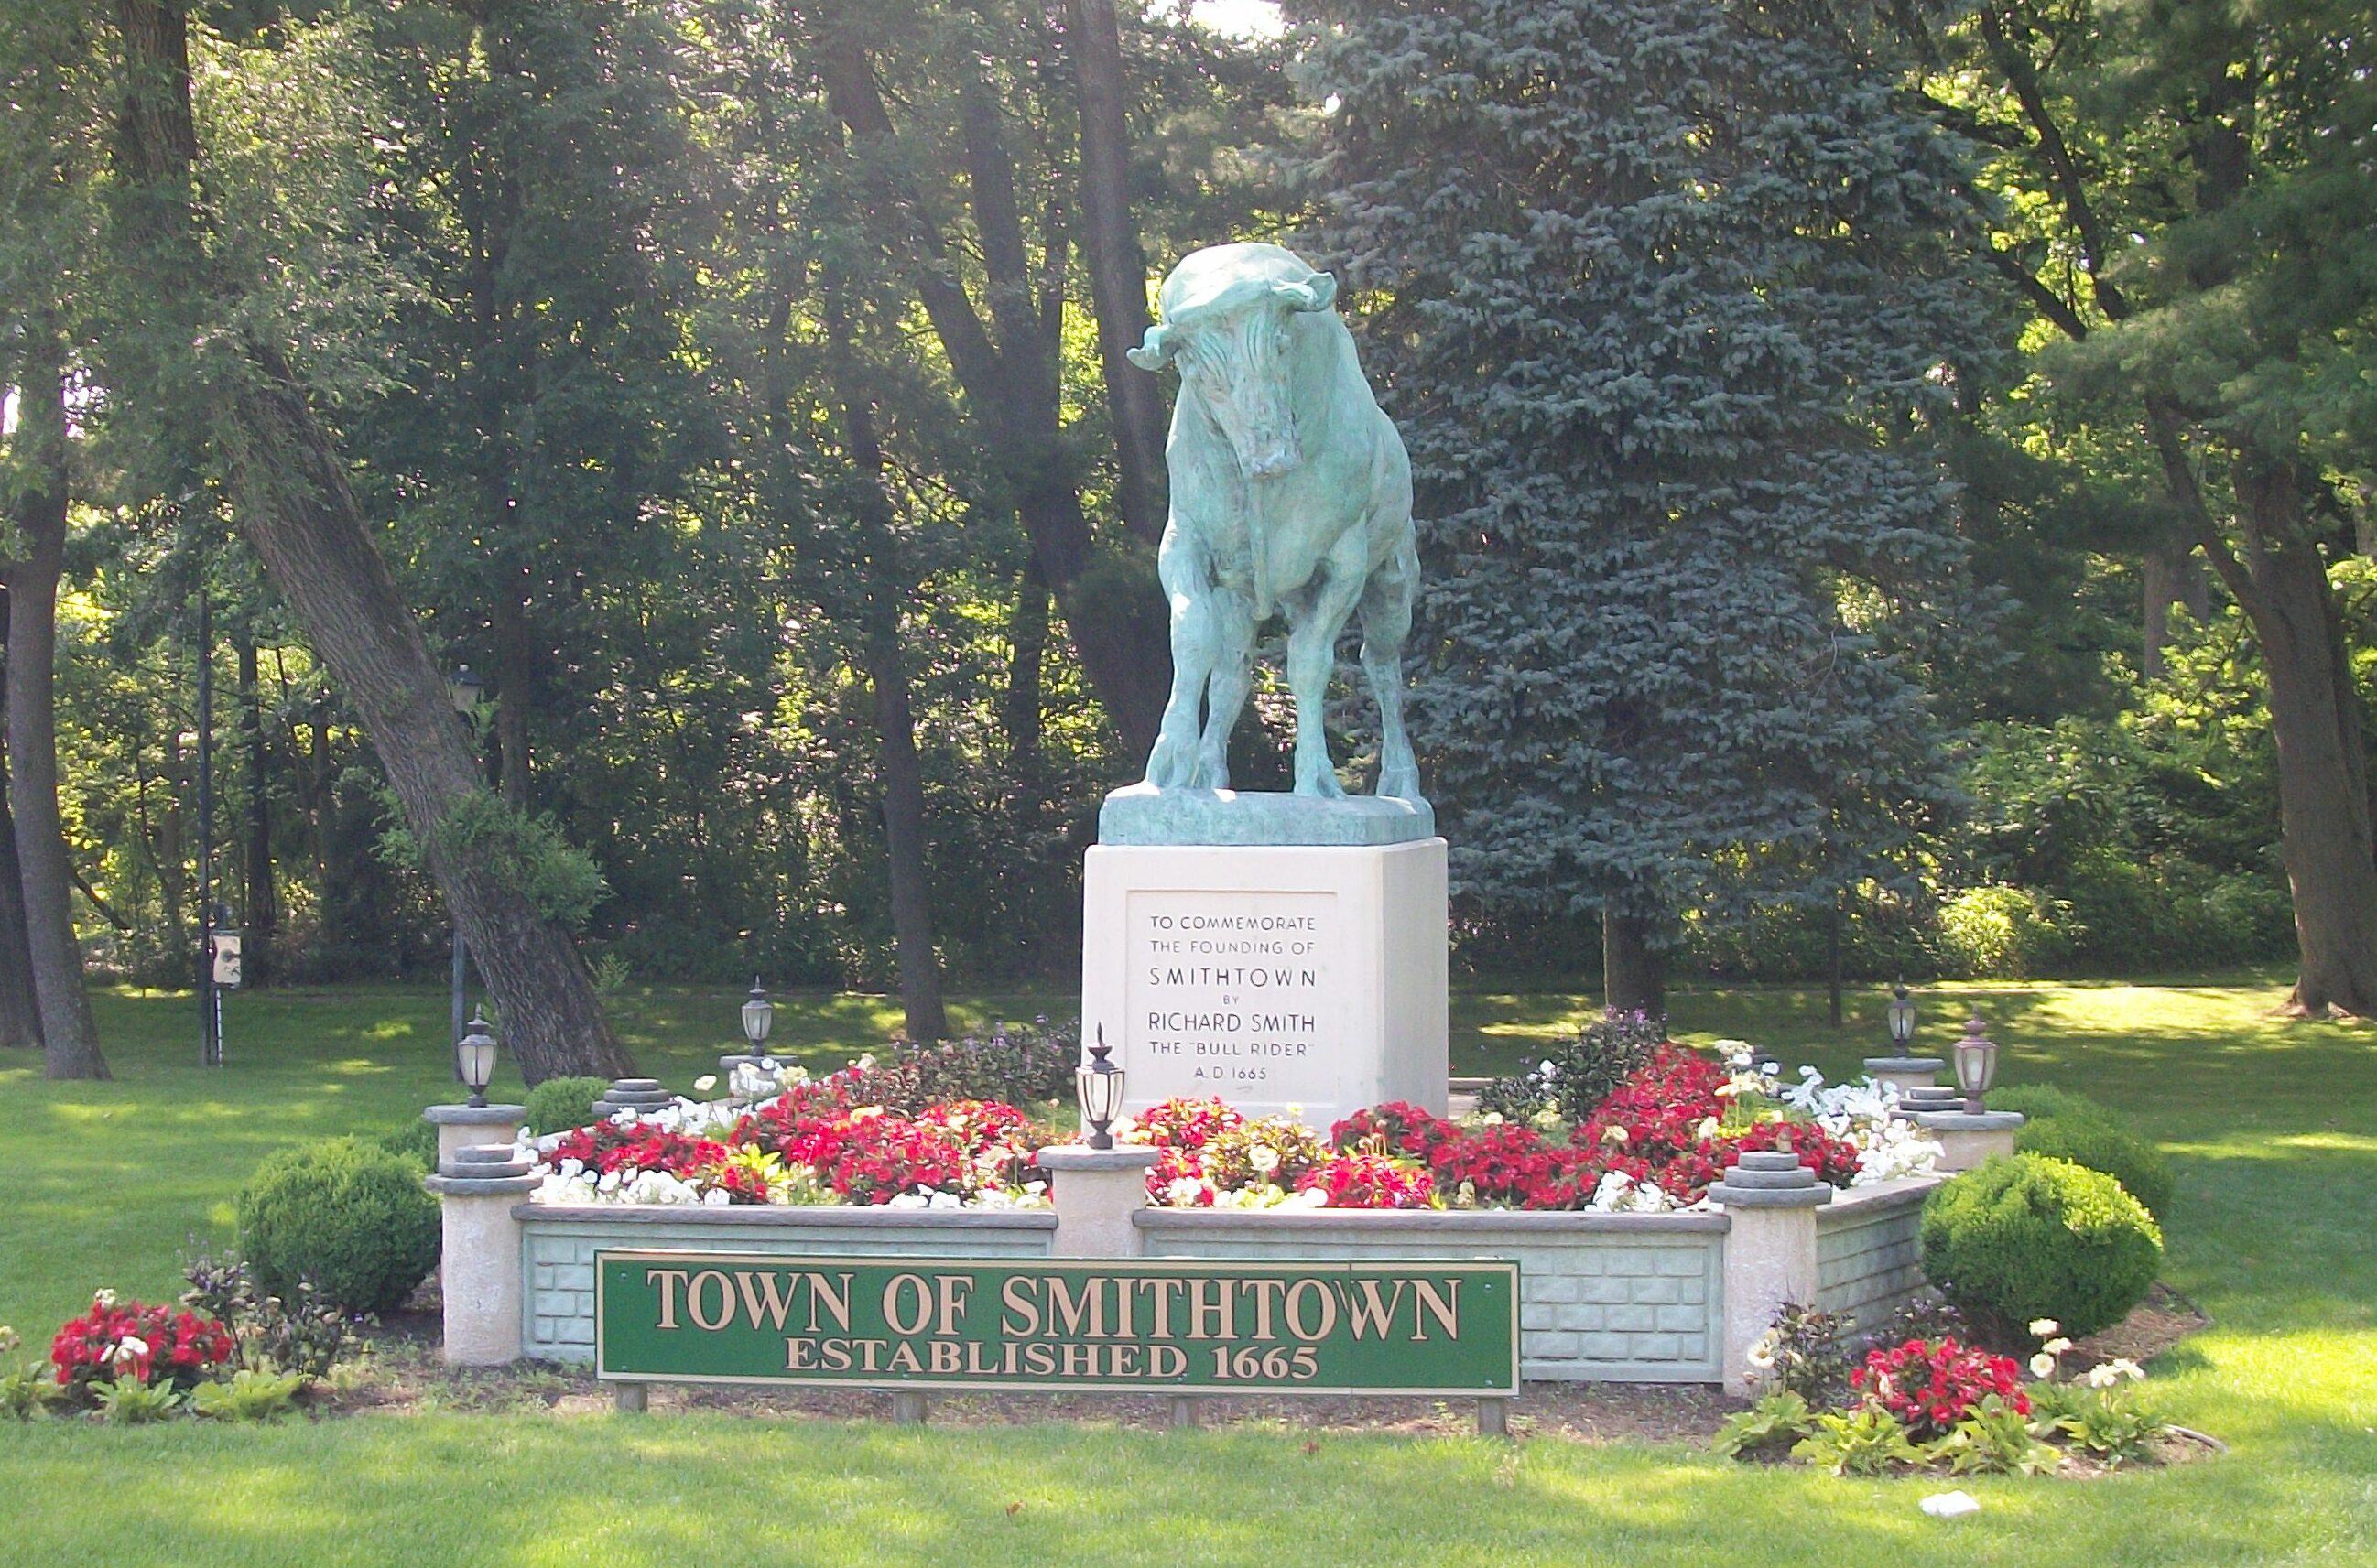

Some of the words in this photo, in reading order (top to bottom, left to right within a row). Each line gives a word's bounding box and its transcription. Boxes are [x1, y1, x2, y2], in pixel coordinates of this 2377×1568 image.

[1150, 915, 1173, 930] TO
[1180, 916, 1316, 931] COMMEMORATE
[1150, 940, 1181, 954] THE
[1190, 940, 1283, 955] FOUNDING
[1291, 942, 1315, 955] OF
[1149, 968, 1316, 988] SMITHTOWN
[1222, 995, 1240, 1006] BY
[1148, 1012, 1242, 1033] RICHARD
[1251, 1014, 1316, 1033] SMITH
[1149, 1041, 1182, 1054] THE
[1232, 1067, 1267, 1080] 1665
[646, 1268, 855, 1334] TOWN
[880, 1272, 975, 1337] OF
[1000, 1273, 1463, 1343] SMITHTOWN
[785, 1336, 1188, 1379] ESTABLISHED
[1209, 1345, 1320, 1380] 1665
